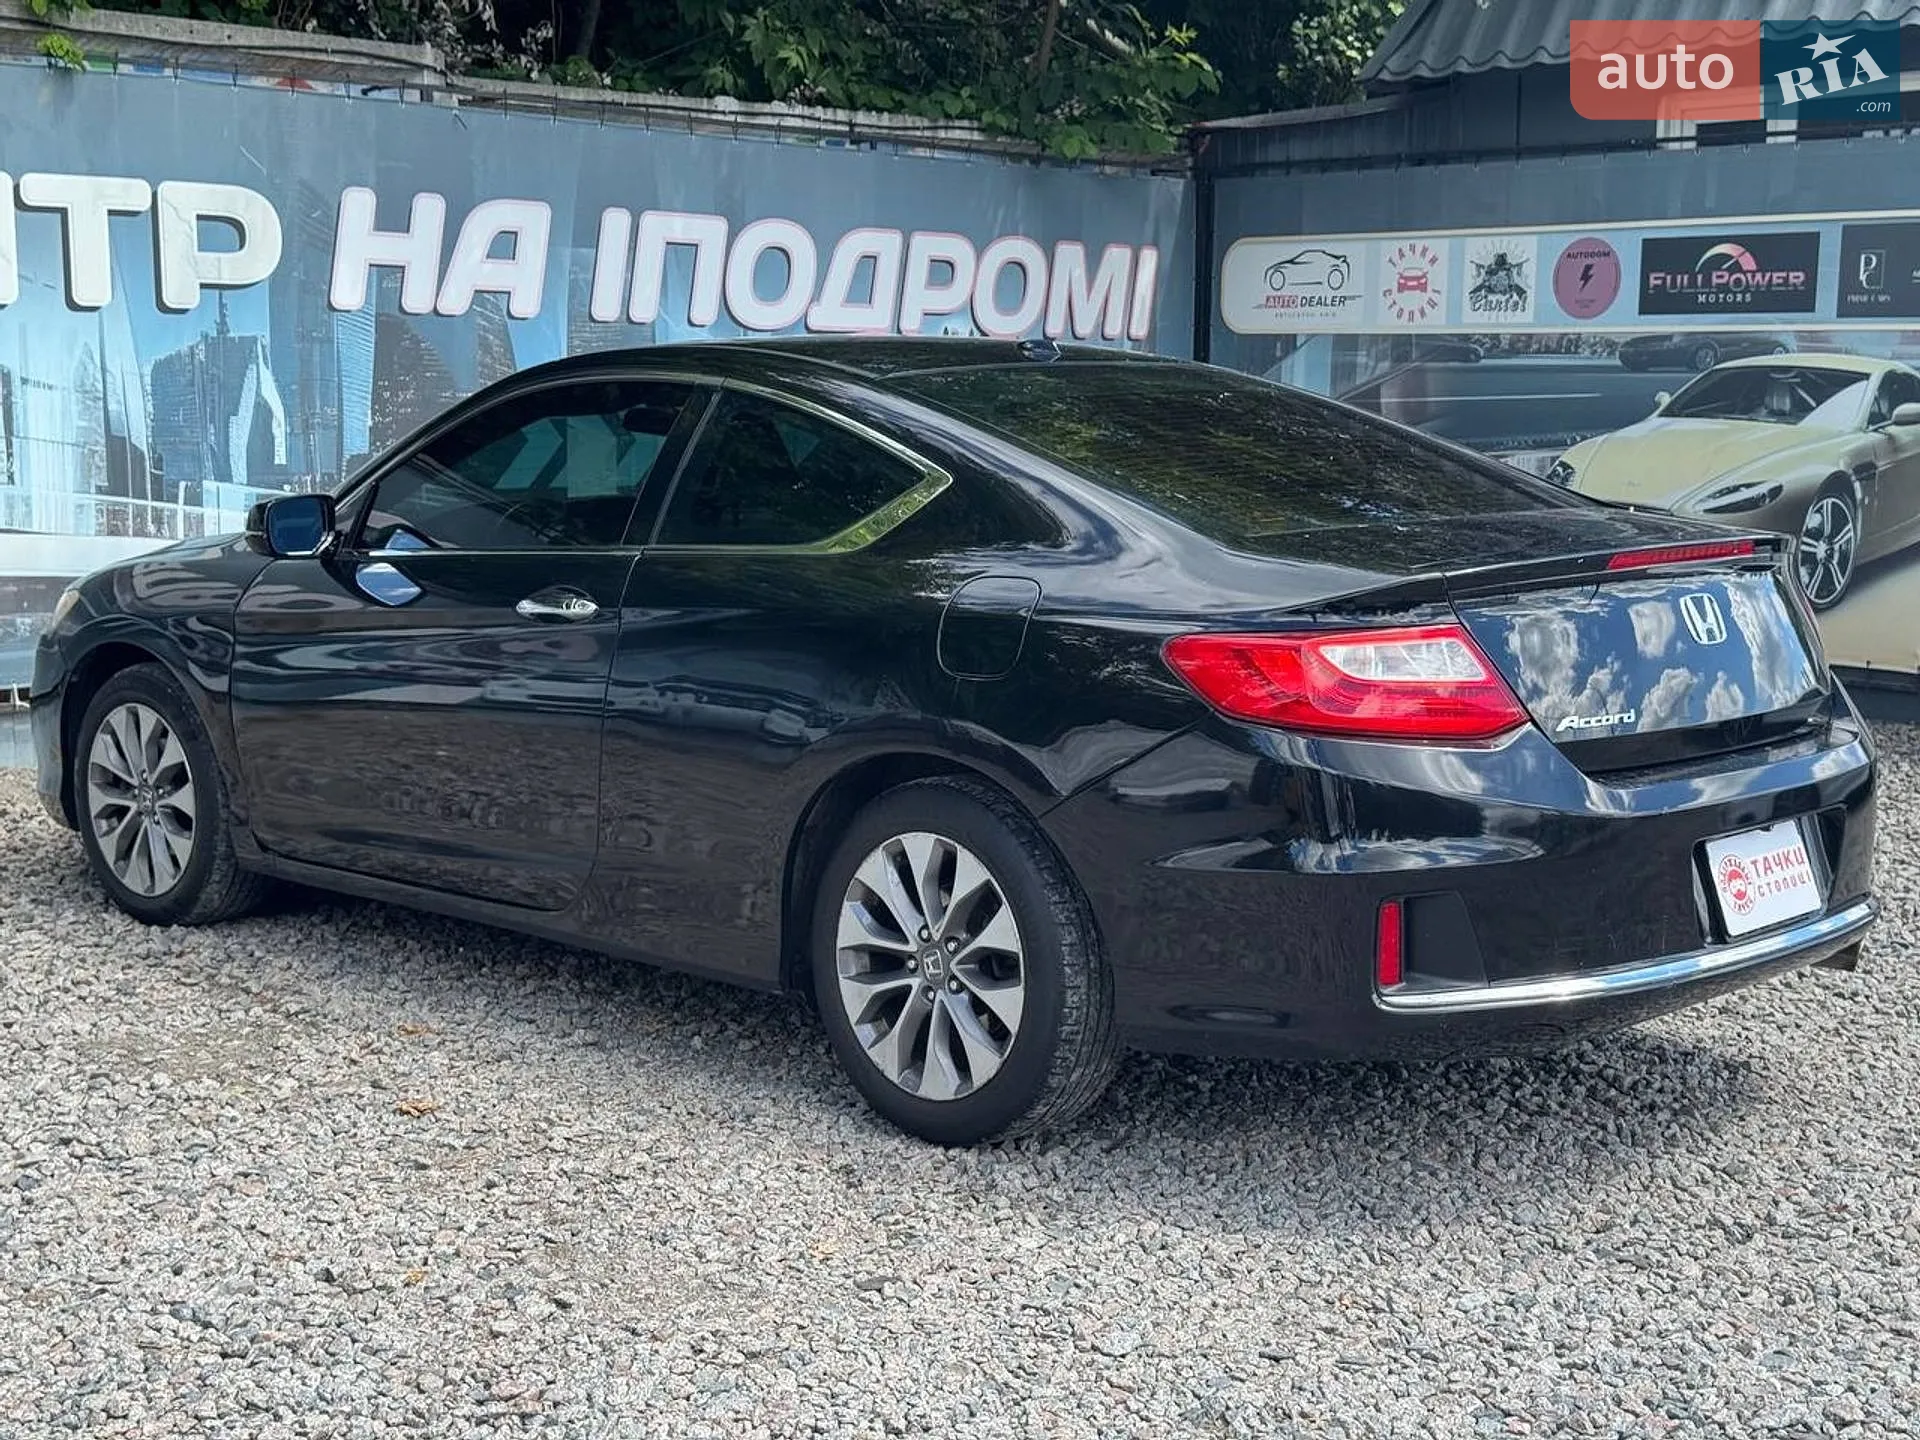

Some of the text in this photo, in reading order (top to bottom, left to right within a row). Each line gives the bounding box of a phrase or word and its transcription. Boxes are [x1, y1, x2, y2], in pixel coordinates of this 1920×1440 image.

[0, 171, 1158, 340] ТР НА ІПОДРОМІ
[1697, 293, 1752, 304] MOTORS
[1555, 708, 1635, 732] Accord
